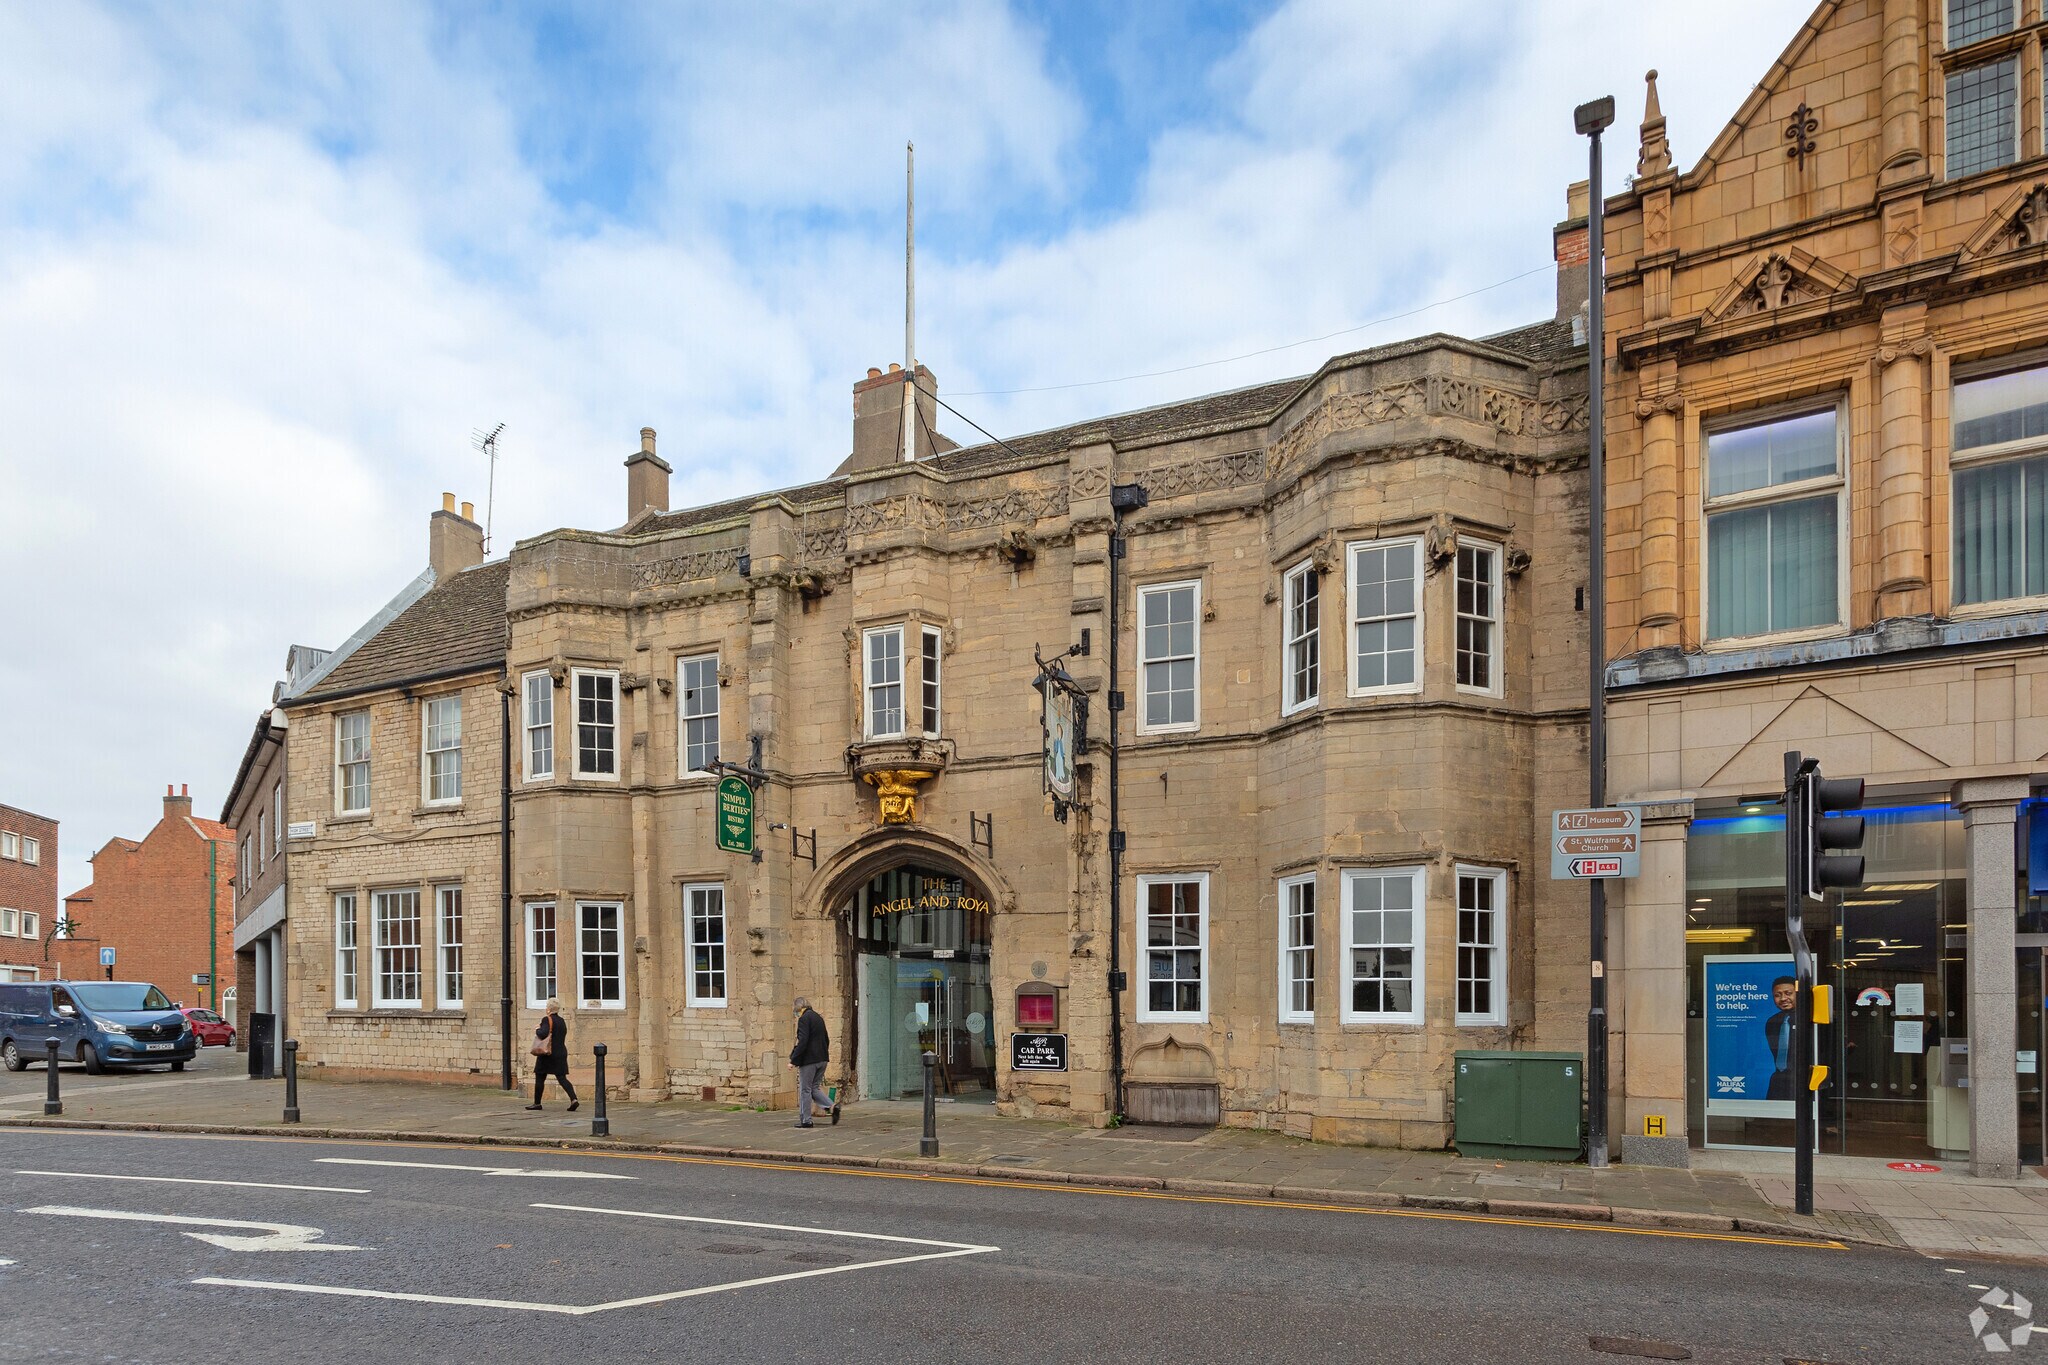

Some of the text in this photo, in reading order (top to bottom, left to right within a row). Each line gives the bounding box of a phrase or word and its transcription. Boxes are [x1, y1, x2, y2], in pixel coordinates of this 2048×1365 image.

[1589, 816, 1622, 824] Museum
[1584, 837, 1620, 845] Wulframs
[923, 878, 947, 890] THE
[872, 898, 915, 918] ANGEL
[919, 895, 950, 908] AND
[1715, 983, 1757, 991] We're the
[1716, 992, 1769, 1002] people here
[1716, 1002, 1749, 1011] to help.
[1037, 1047, 1055, 1055] PARK
[1460, 1064, 1468, 1074] 5
[1565, 1066, 1573, 1076] 5
[1647, 1117, 1663, 1135] H
